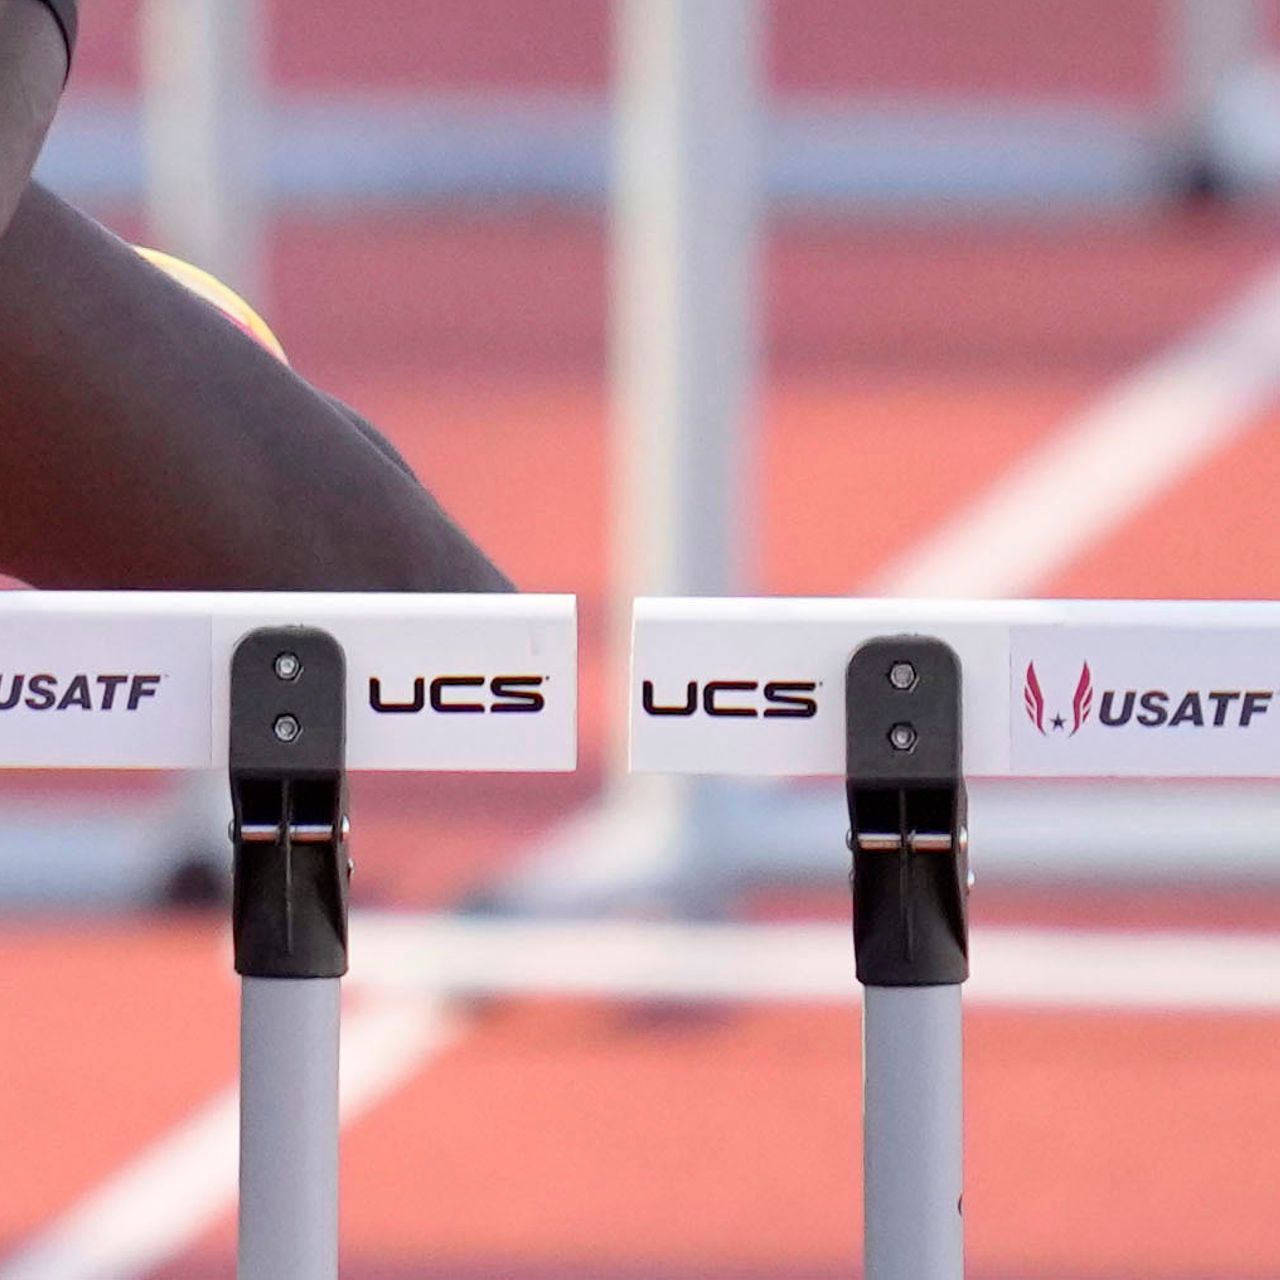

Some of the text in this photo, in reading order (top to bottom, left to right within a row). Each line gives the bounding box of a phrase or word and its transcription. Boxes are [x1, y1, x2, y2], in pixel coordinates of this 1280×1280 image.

[368, 675, 546, 714] UCS
[641, 679, 819, 719] UCS
[1097, 690, 1275, 728] USATF
